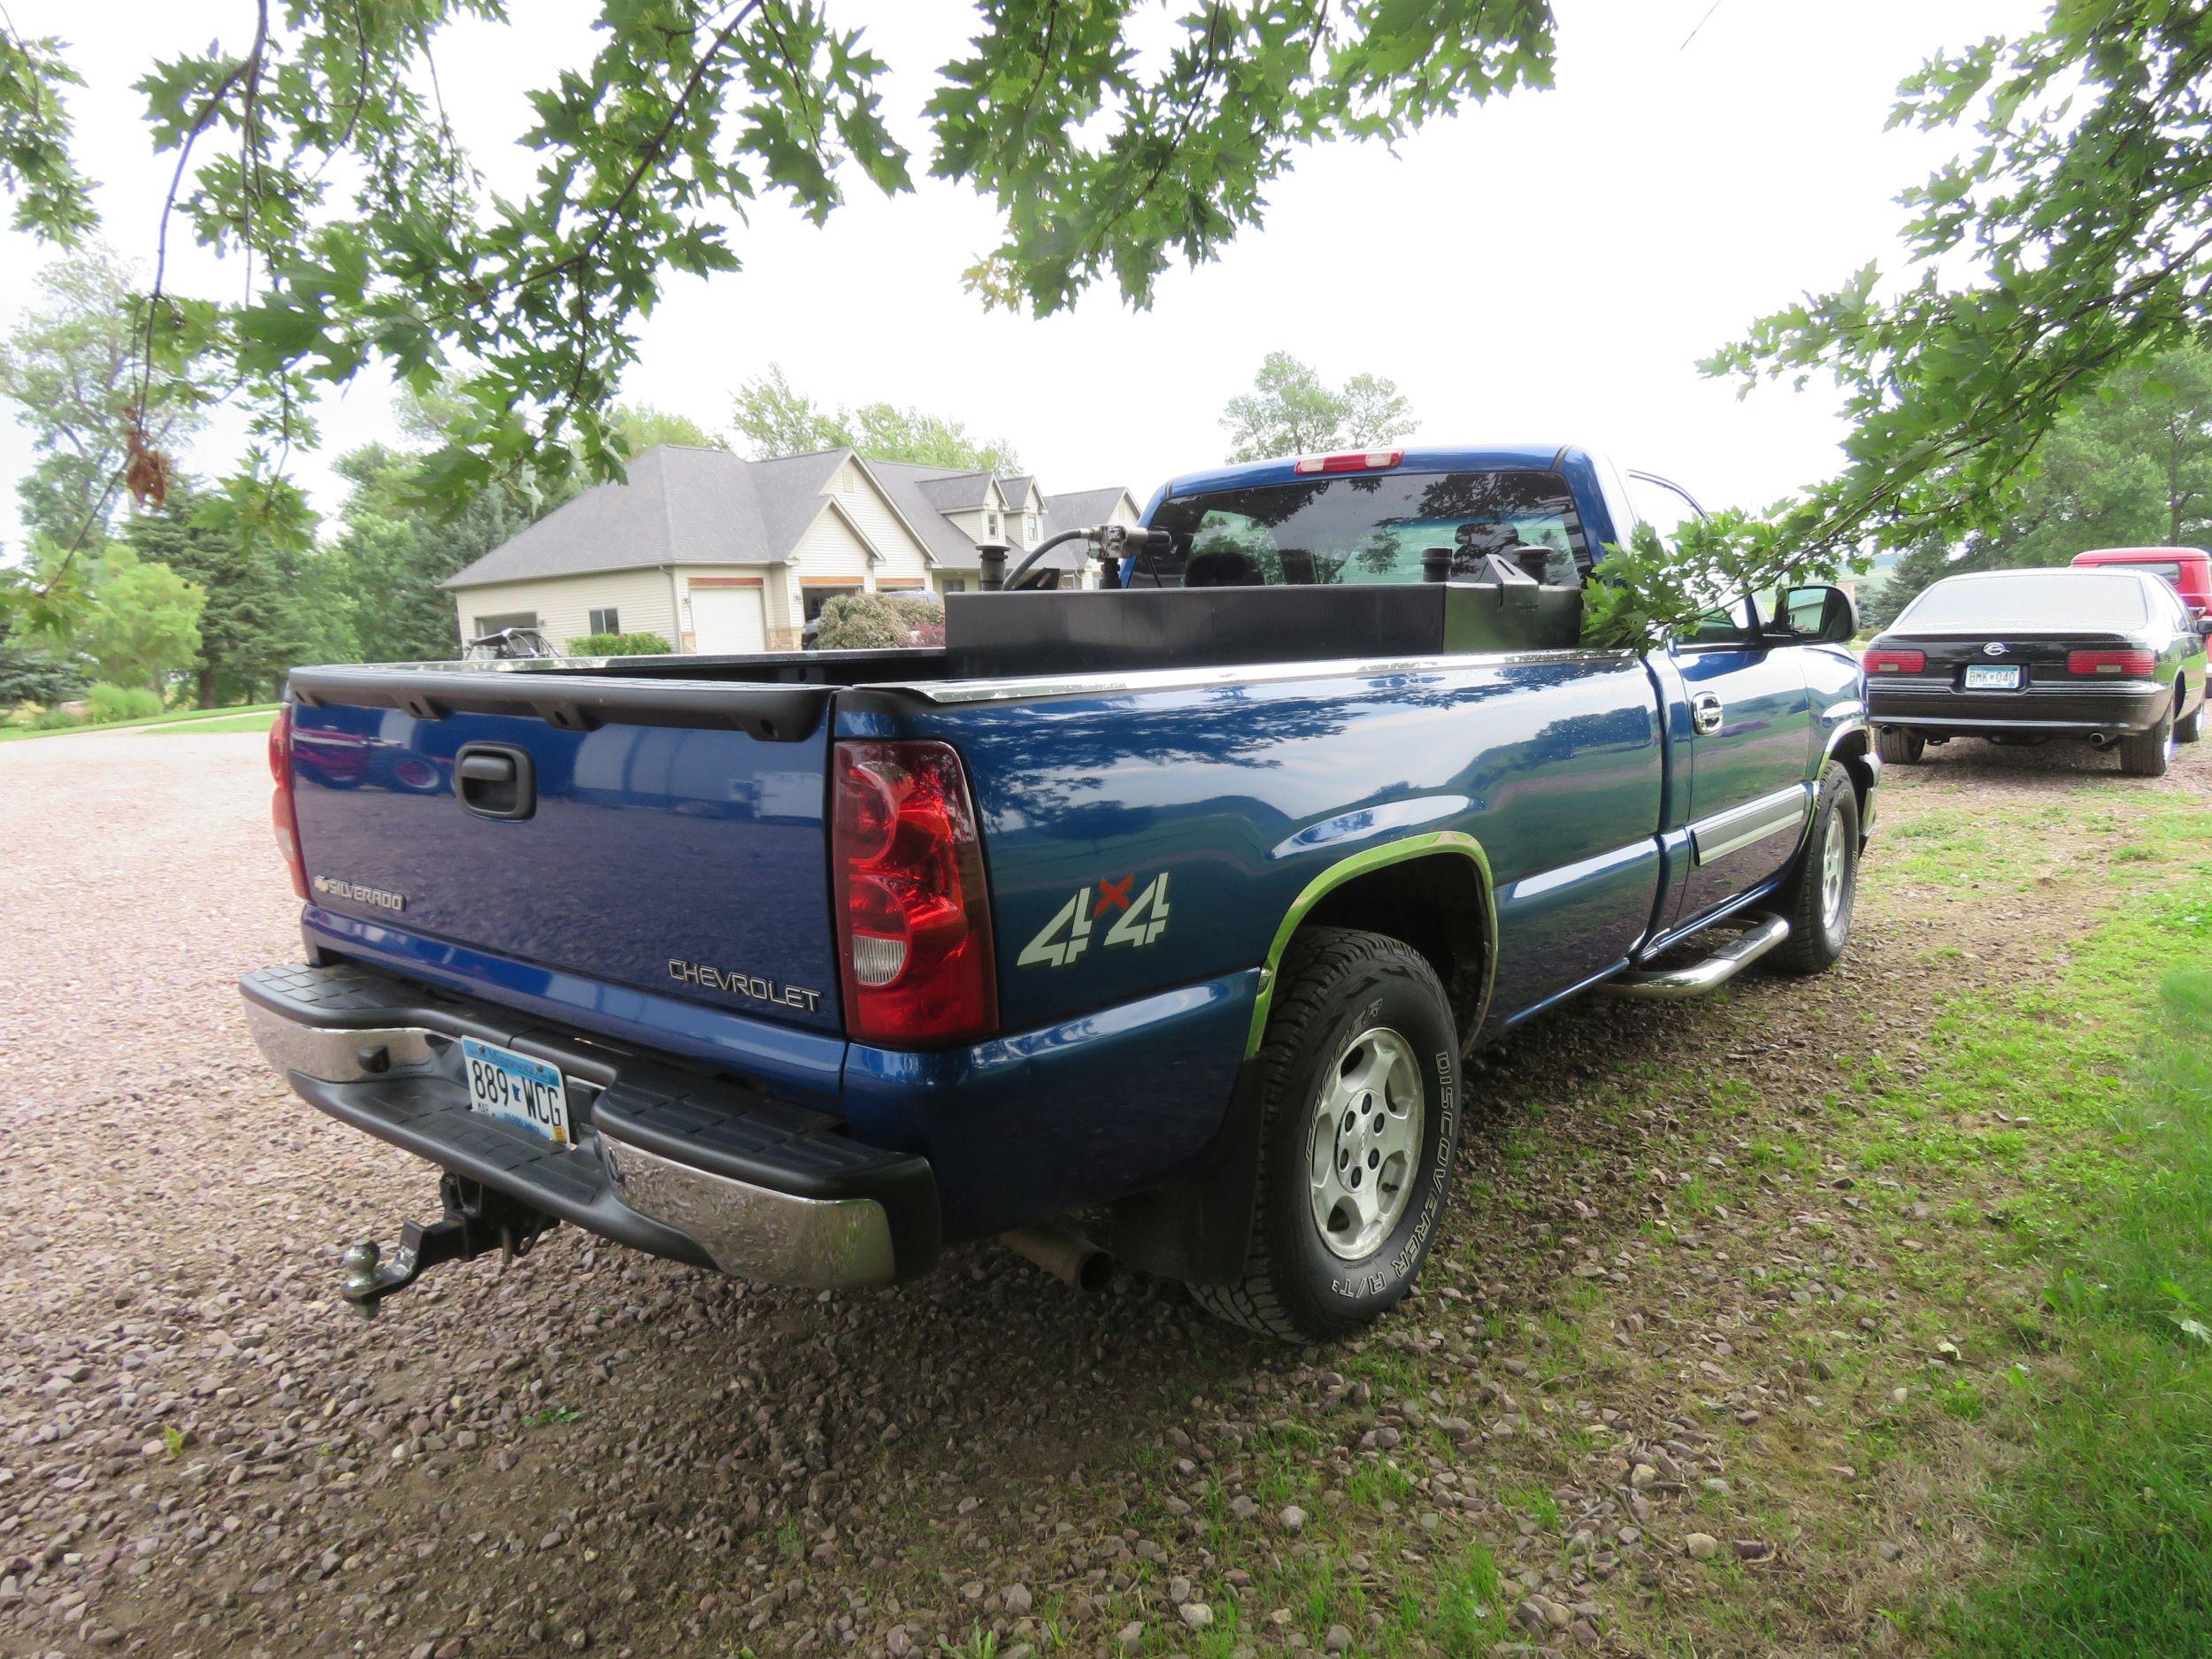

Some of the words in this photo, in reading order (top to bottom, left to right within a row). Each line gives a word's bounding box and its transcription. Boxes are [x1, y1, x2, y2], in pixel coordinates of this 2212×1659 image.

[328, 879, 404, 911] SILVERADO
[668, 958, 821, 1012] CHEVROLET
[472, 1059, 509, 1107] 889
[521, 1075, 562, 1127] WCG
[1391, 1051, 1454, 1279] DISCOVERER
